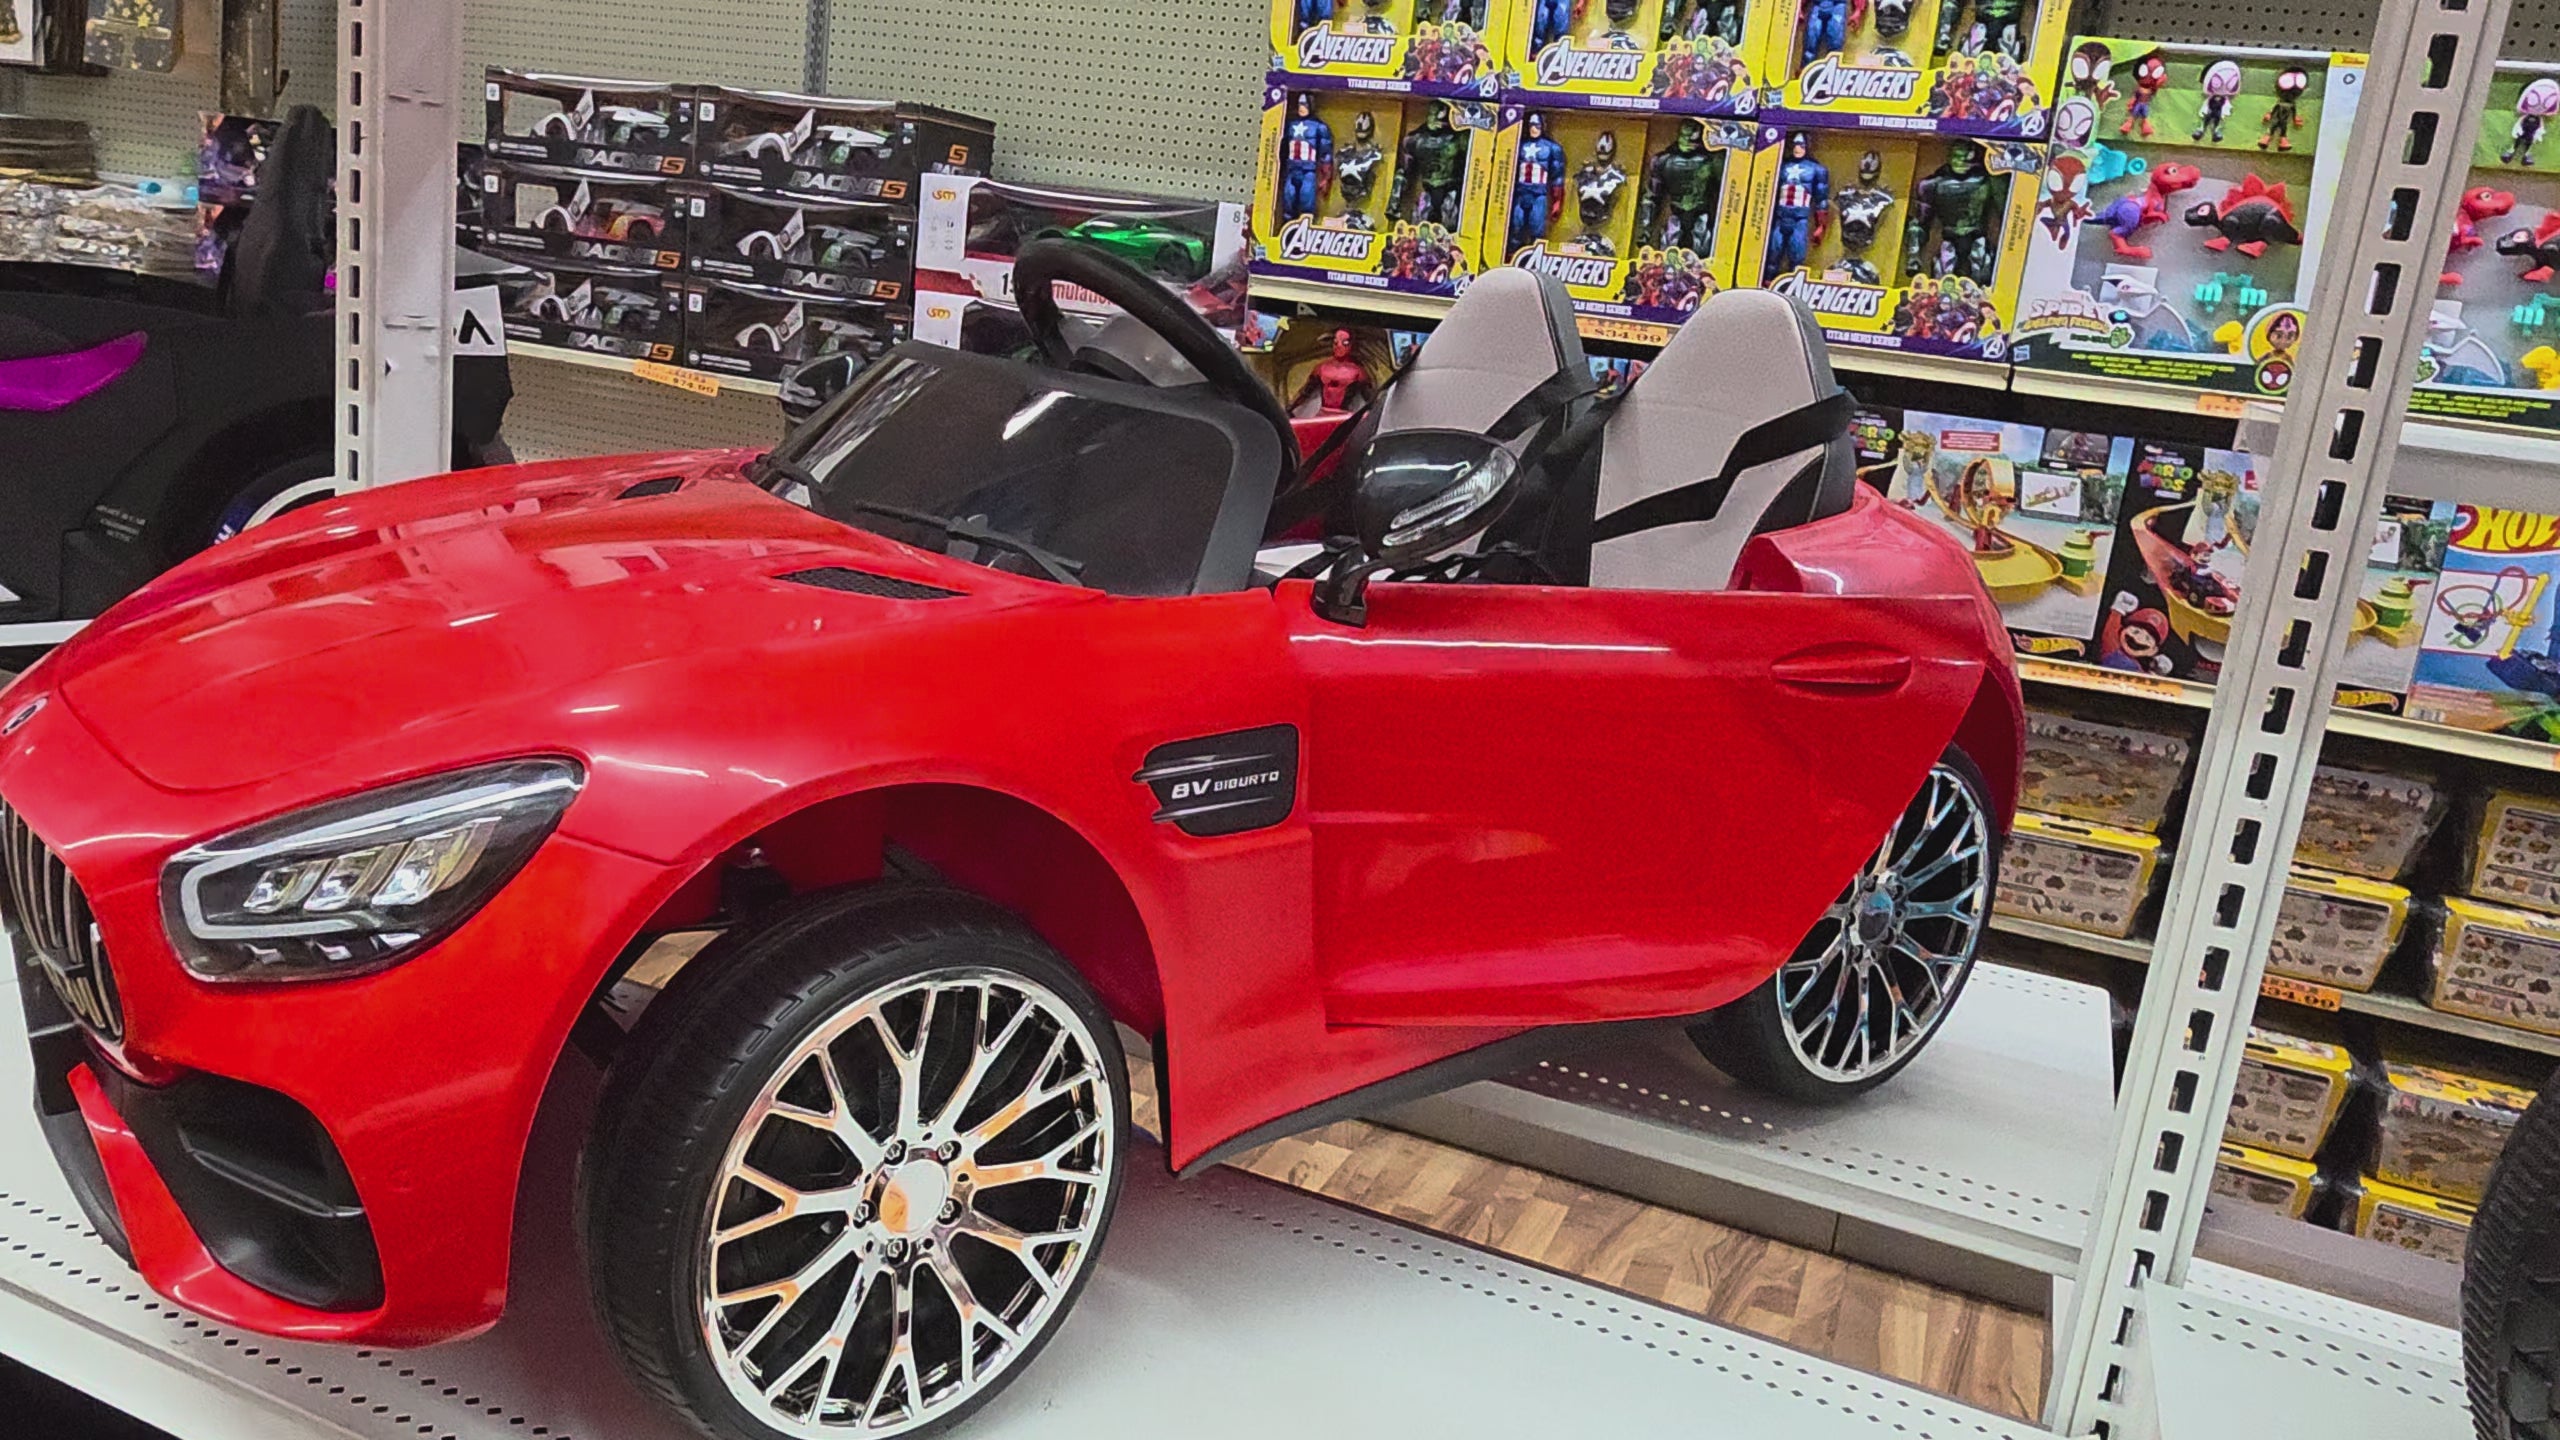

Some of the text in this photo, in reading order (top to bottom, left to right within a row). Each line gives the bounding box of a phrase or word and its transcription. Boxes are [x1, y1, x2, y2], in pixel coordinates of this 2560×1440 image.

[1301, 24, 1395, 67] AVENGERS
[1538, 39, 1642, 84] AVENGERS
[1802, 57, 1918, 103] AVENGERS
[1281, 217, 1374, 259] AVENGERS
[1213, 770, 1280, 792] BIBURTO
